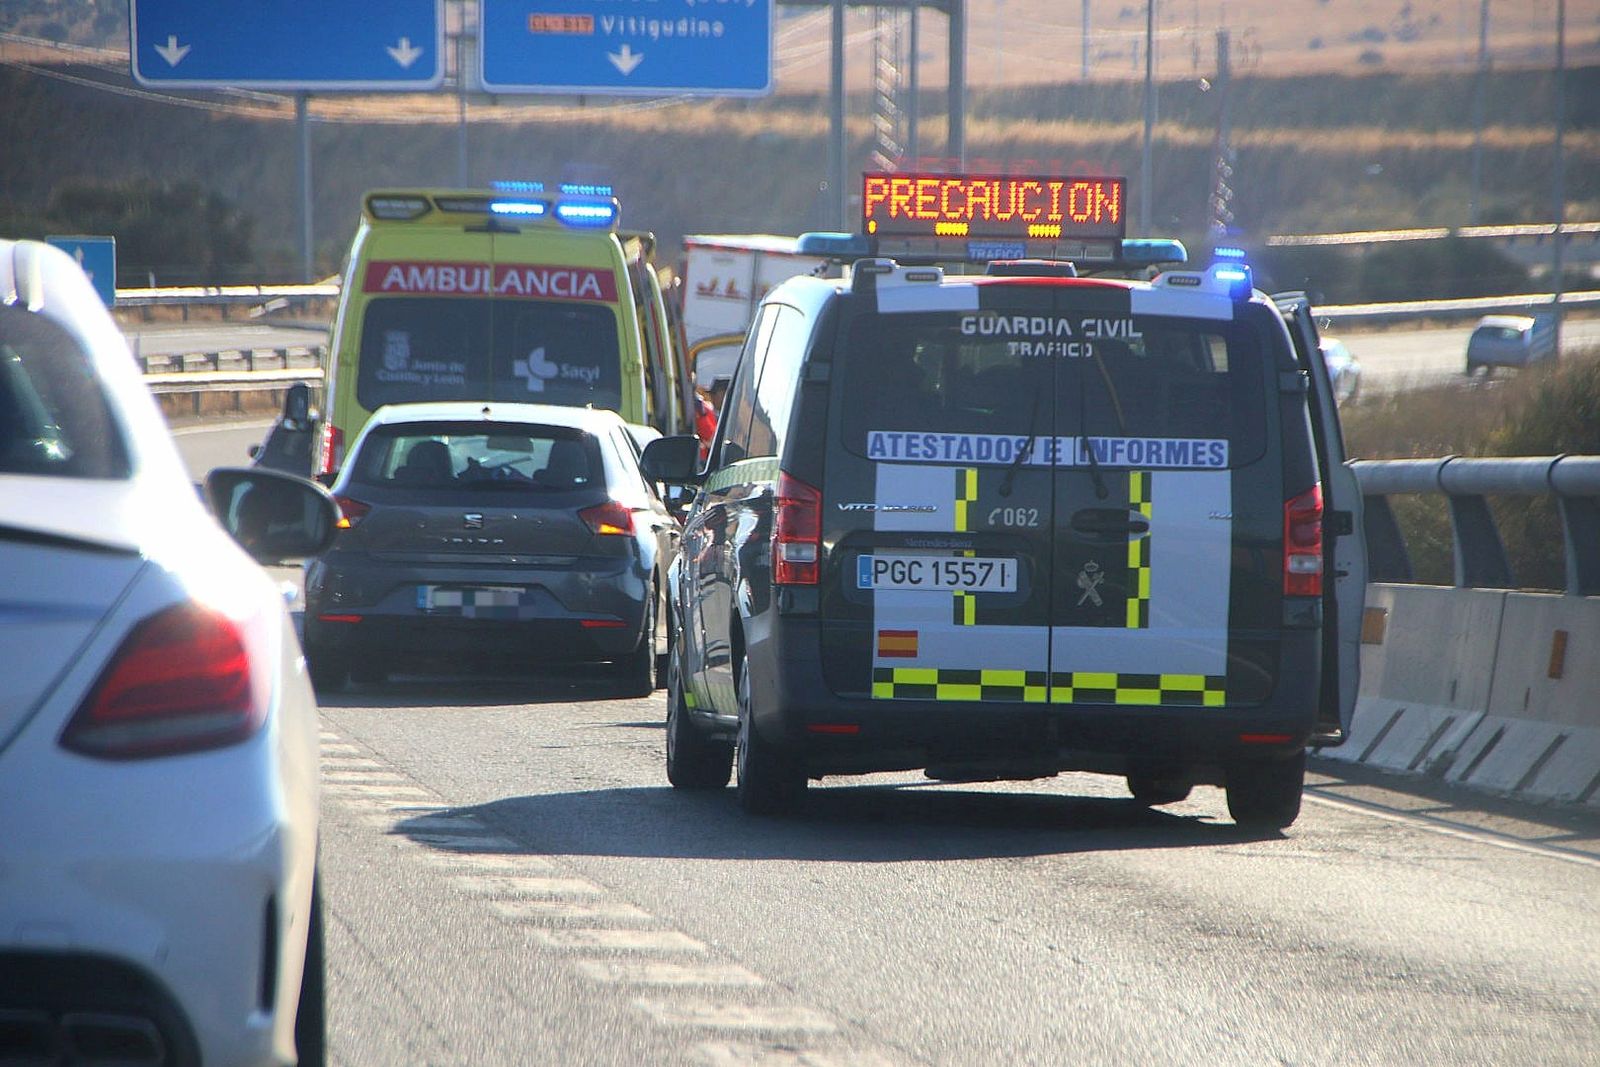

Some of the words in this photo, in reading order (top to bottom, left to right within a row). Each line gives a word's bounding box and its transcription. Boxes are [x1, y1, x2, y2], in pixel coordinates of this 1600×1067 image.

[601, 15, 724, 40] Vitigudino
[865, 178, 1120, 223] PRECAUCION
[382, 265, 602, 296] AMBULANCIA
[961, 316, 1072, 336] GUARDIA
[1081, 318, 1143, 338] CIVIL
[1008, 341, 1093, 357] TRAFICO
[561, 364, 599, 380] Sacyl
[869, 432, 1031, 462] ATESTADOS
[1043, 437, 1063, 463] E
[1080, 438, 1226, 467] INFORMES
[1003, 508, 1039, 527] 062
[874, 560, 922, 585] PGC
